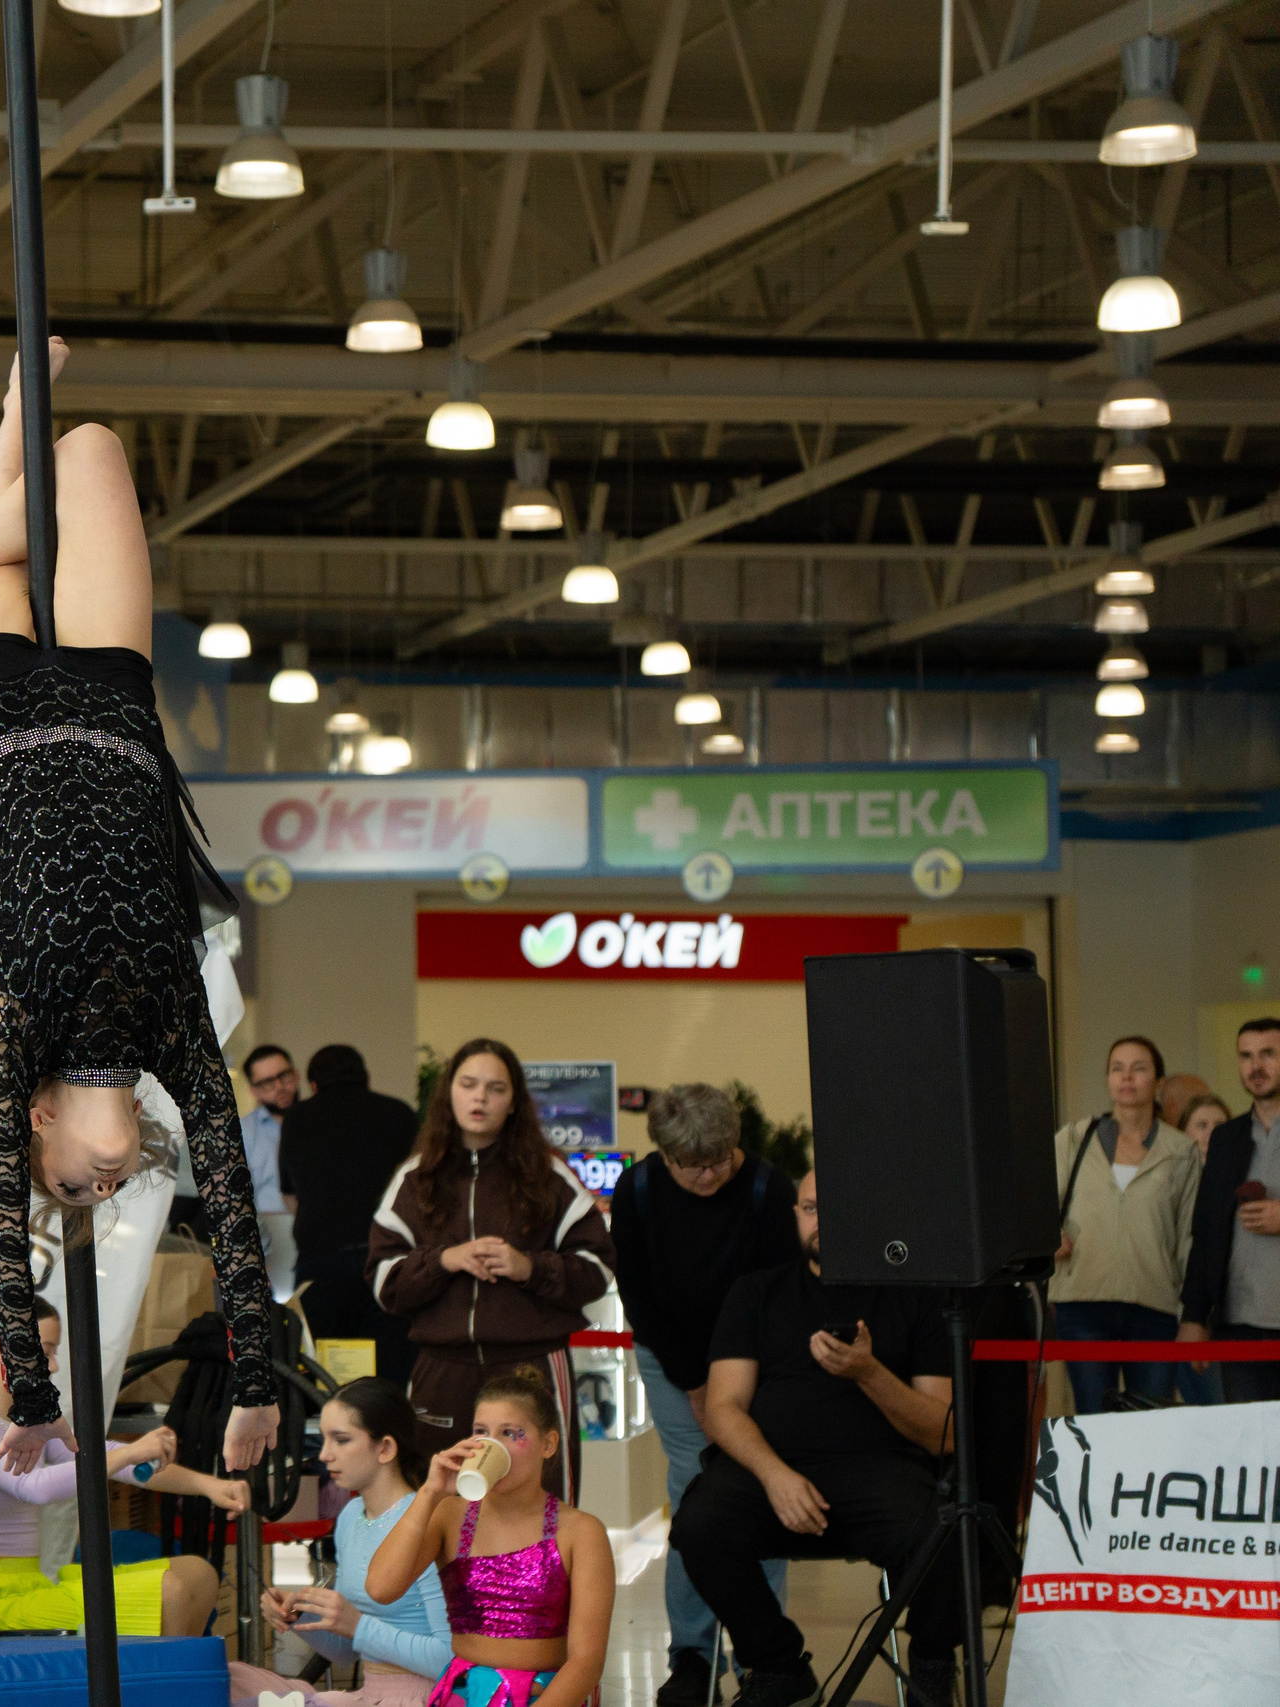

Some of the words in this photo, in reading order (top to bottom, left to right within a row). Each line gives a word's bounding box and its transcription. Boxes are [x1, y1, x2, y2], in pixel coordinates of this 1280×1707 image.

[721, 789, 988, 839] АПТЕКА
[1110, 1465, 1280, 1523] НАШ
[1108, 1531, 1151, 1554] pole
[1159, 1532, 1236, 1556] dance
[1242, 1536, 1258, 1556] &
[1022, 1581, 1114, 1606] ЦЕНТР
